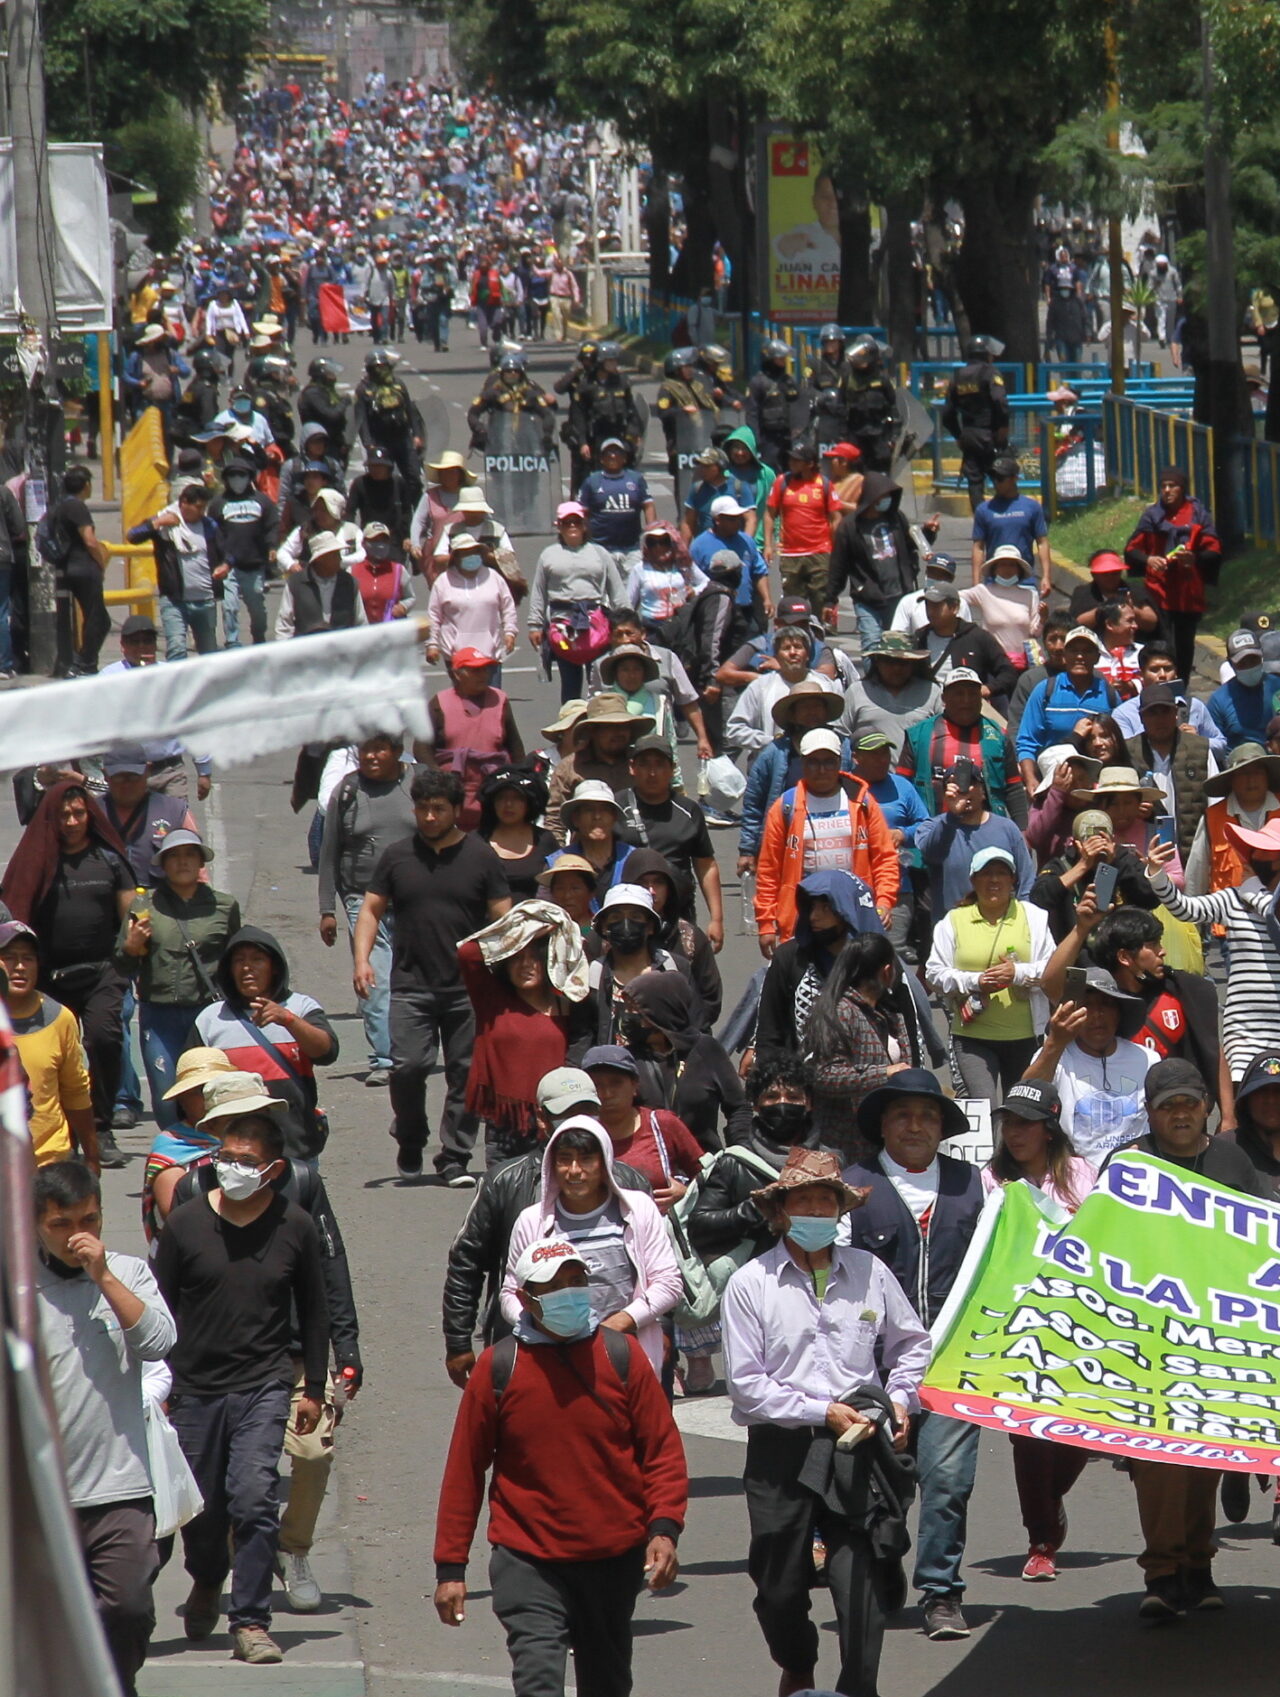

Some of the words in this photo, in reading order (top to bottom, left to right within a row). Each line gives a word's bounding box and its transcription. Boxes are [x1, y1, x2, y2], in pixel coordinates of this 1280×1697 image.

[1102, 1255, 1196, 1318] LA
[1161, 1353, 1276, 1385] San
[951, 1401, 1261, 1465] Mercados
